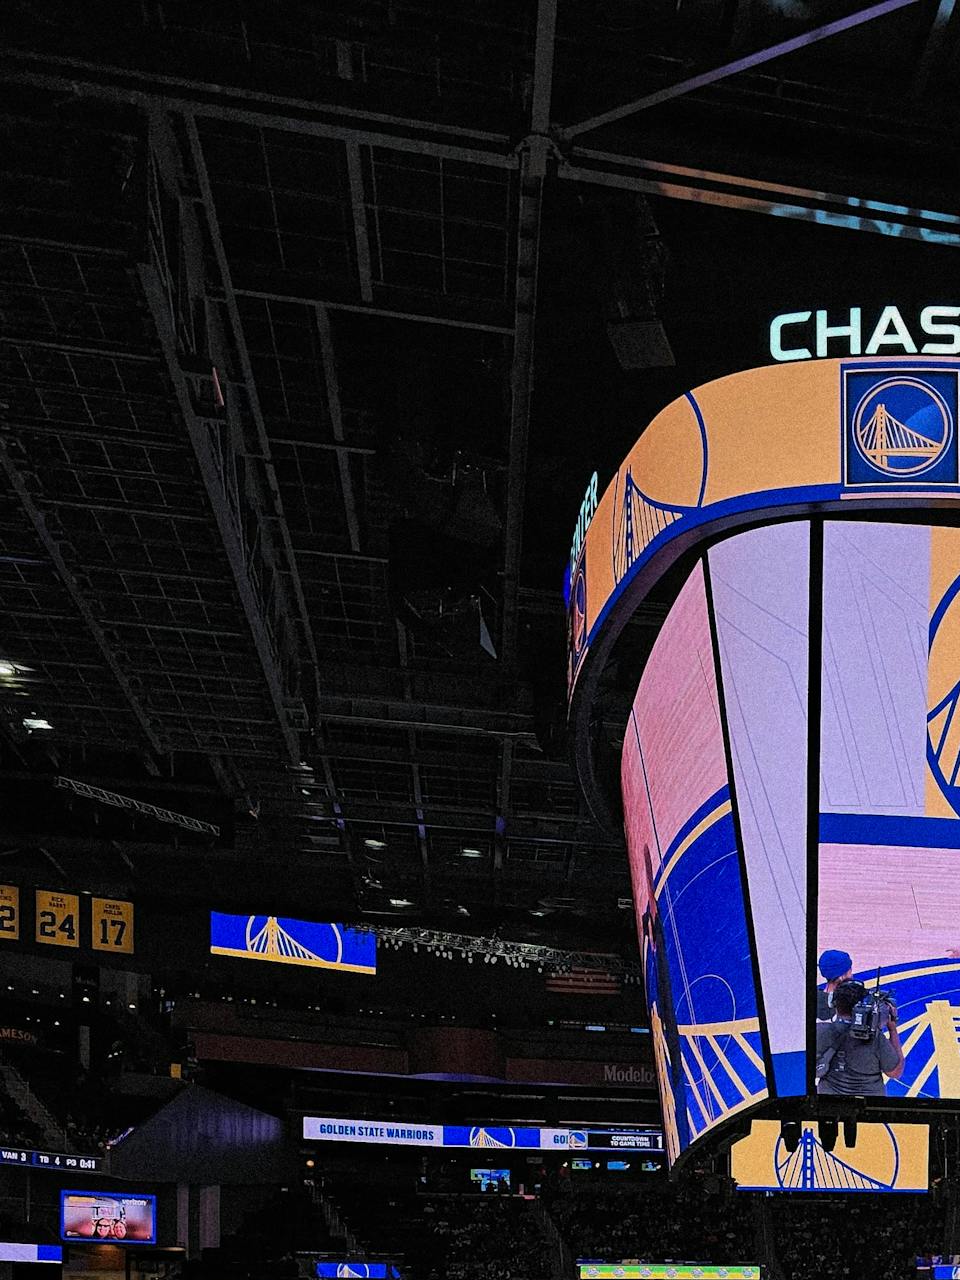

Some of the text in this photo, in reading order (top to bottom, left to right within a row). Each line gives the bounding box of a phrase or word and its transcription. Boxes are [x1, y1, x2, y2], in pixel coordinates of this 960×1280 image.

[40, 911, 76, 940] 24
[100, 919, 127, 946] 17
[603, 1064, 654, 1083] Modelo
[319, 1123, 434, 1141] GOLDEN STATE WARRIORS
[2, 1150, 27, 1162] VAN 3
[54, 1156, 61, 1166] 4
